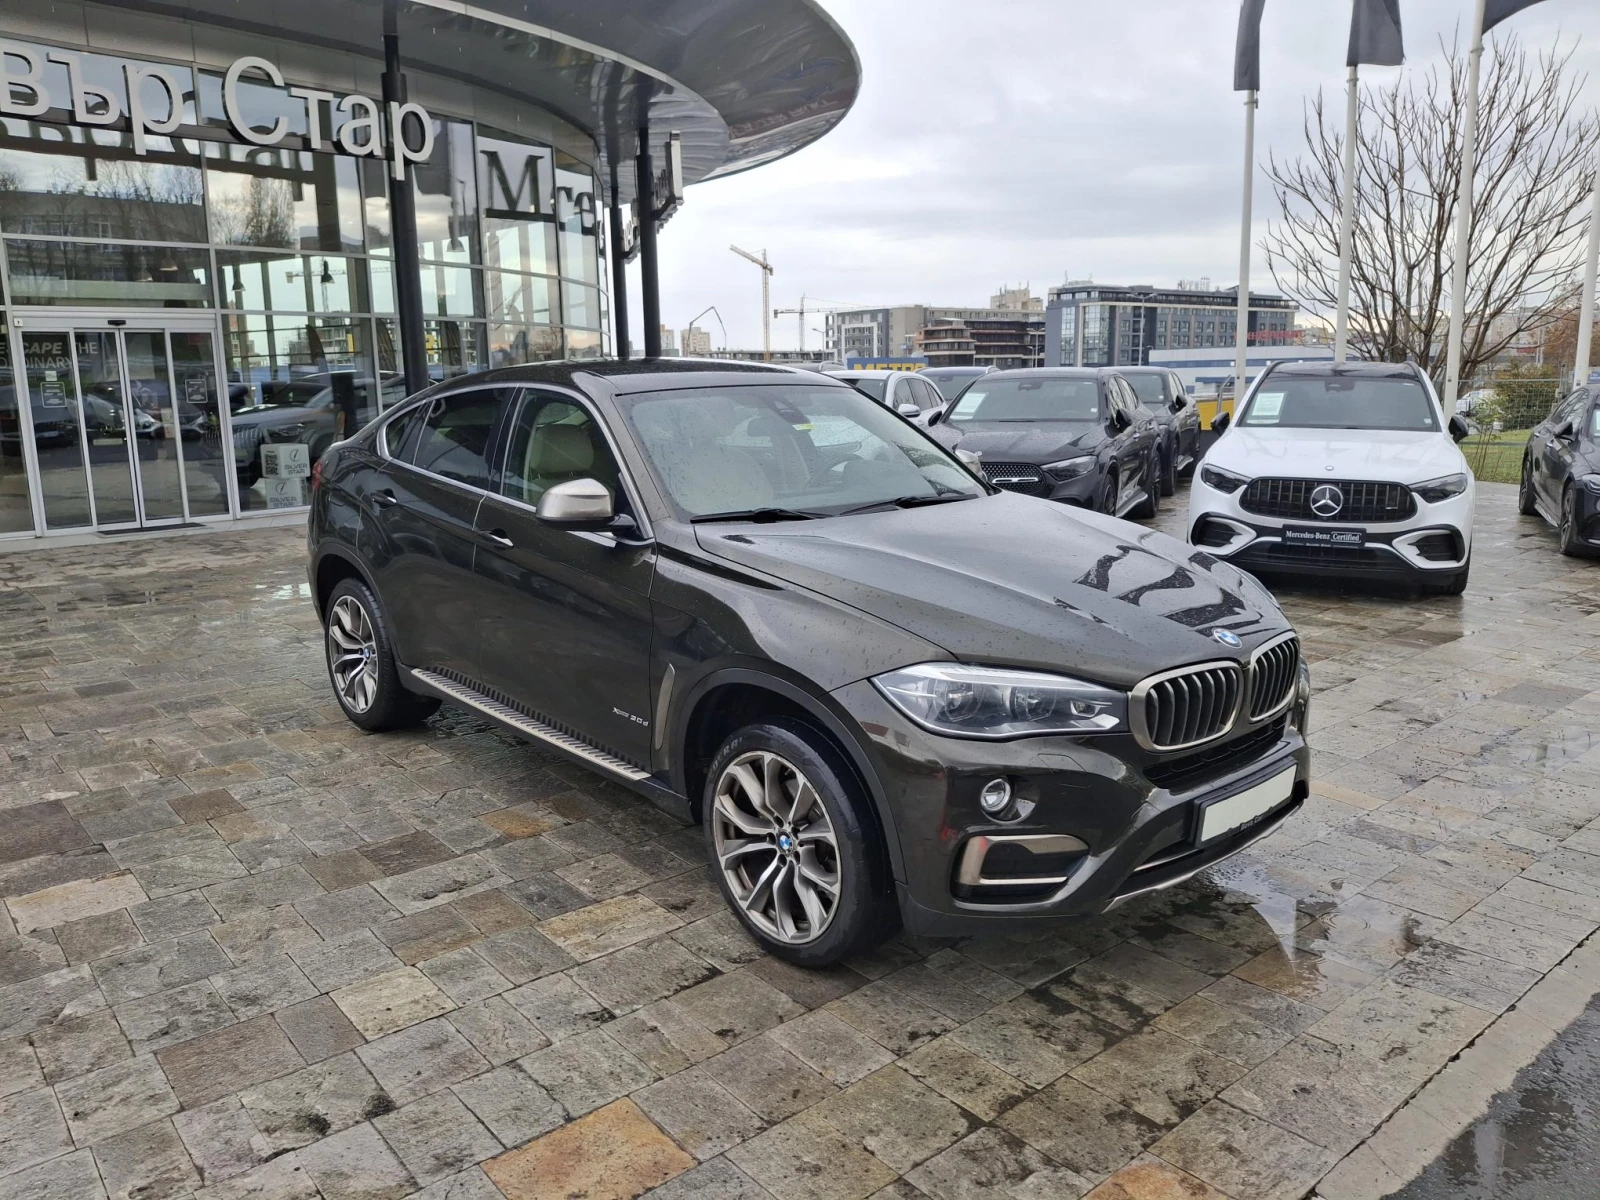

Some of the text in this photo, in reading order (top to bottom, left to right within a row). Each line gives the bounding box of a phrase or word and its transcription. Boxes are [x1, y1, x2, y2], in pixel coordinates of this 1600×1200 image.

[222, 56, 435, 181] Стар
[0, 342, 99, 354] ECAPE HE
[0, 357, 73, 368] ODINARY
[1286, 531, 1360, 541] Mercedes-Benz Certified
